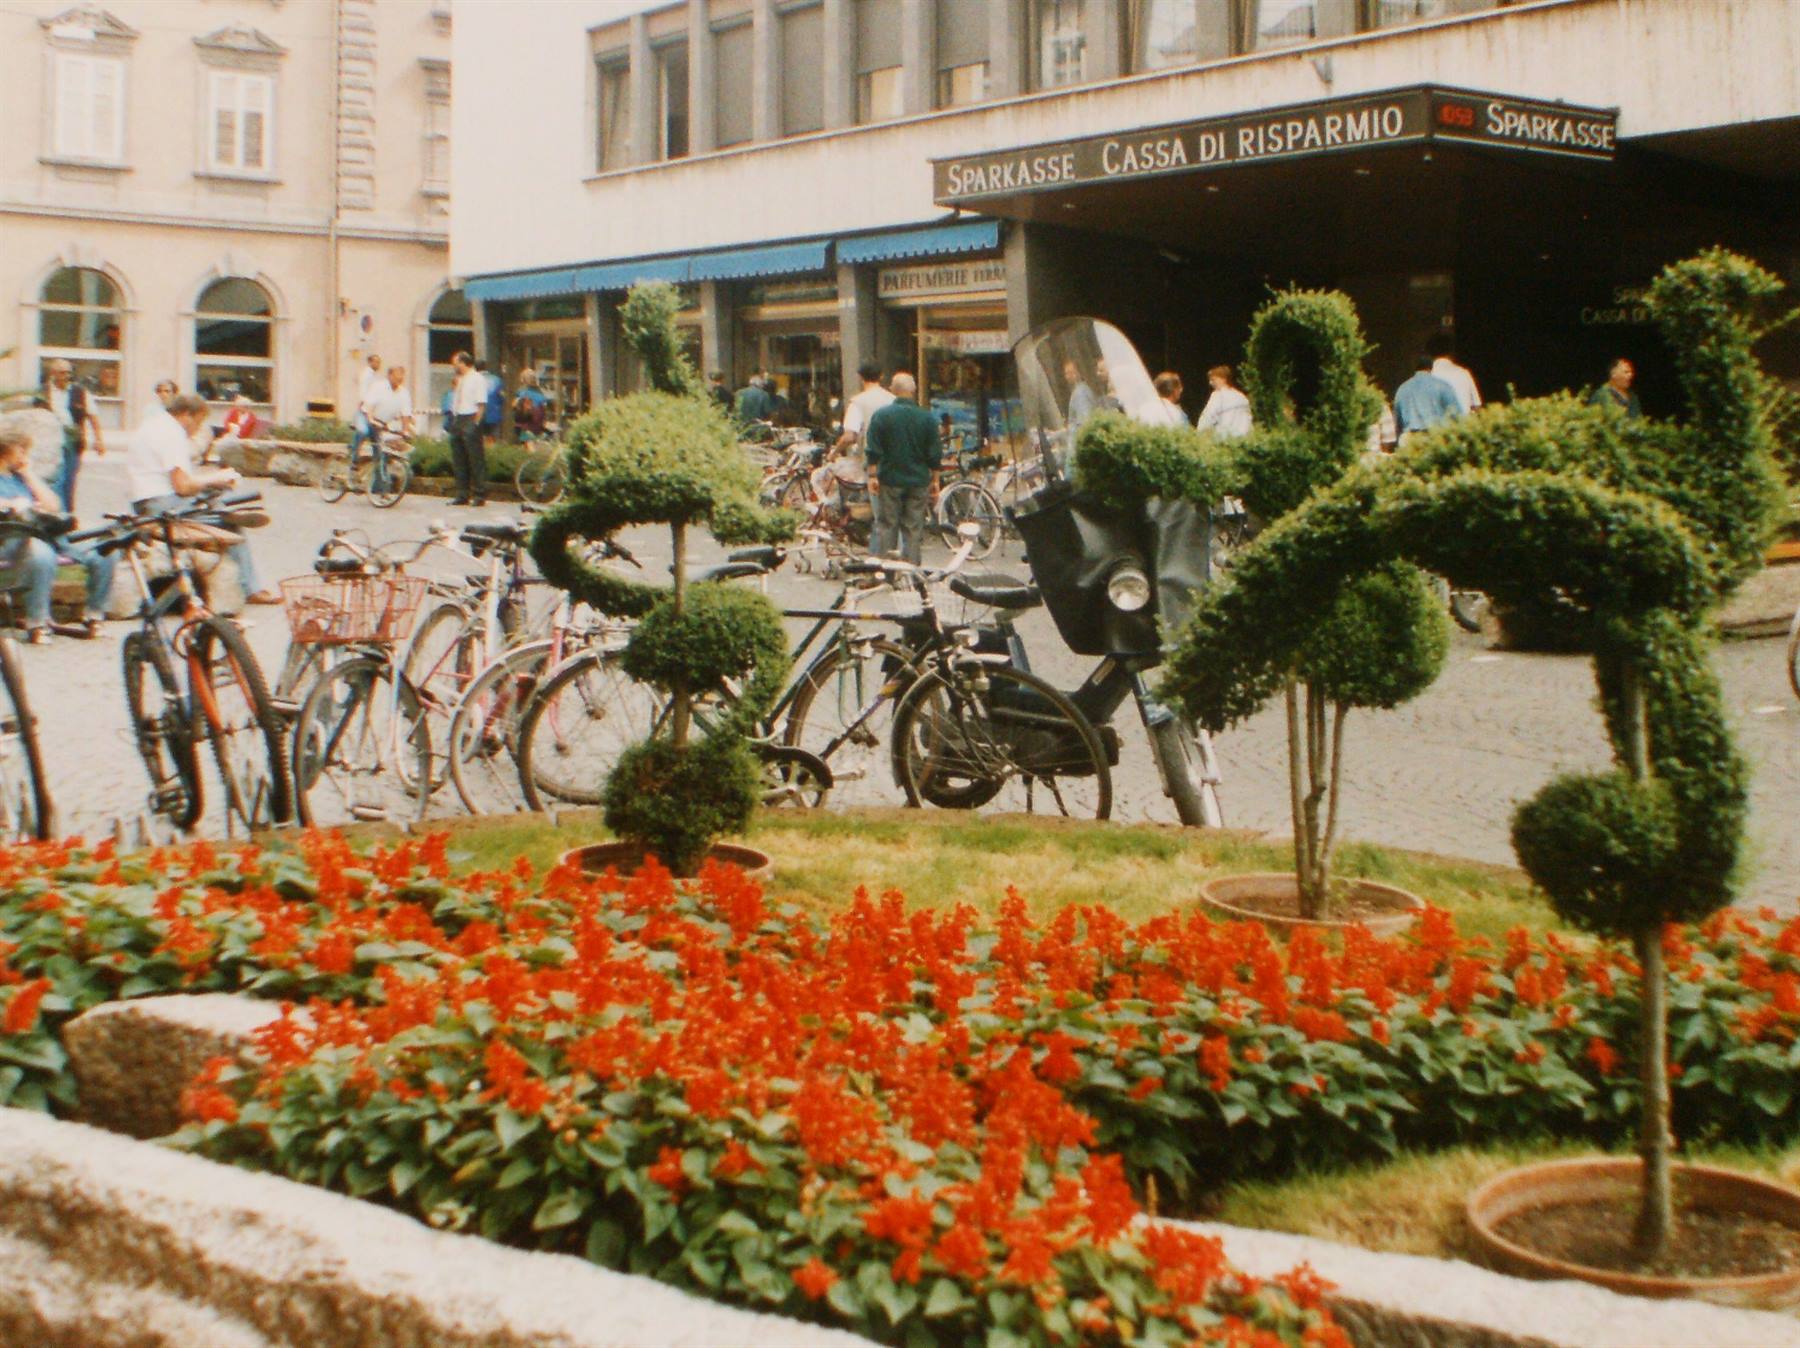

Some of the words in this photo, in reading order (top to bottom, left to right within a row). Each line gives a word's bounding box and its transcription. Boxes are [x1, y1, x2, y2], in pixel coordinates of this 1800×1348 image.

[947, 153, 1077, 195] SPARKASSE
[1102, 138, 1188, 175] CASSA
[1199, 131, 1226, 163] DI
[1238, 105, 1404, 157] RISPARMIO
[1486, 103, 1615, 150] SPARKASSE
[883, 269, 968, 291] PARFUMERIE
